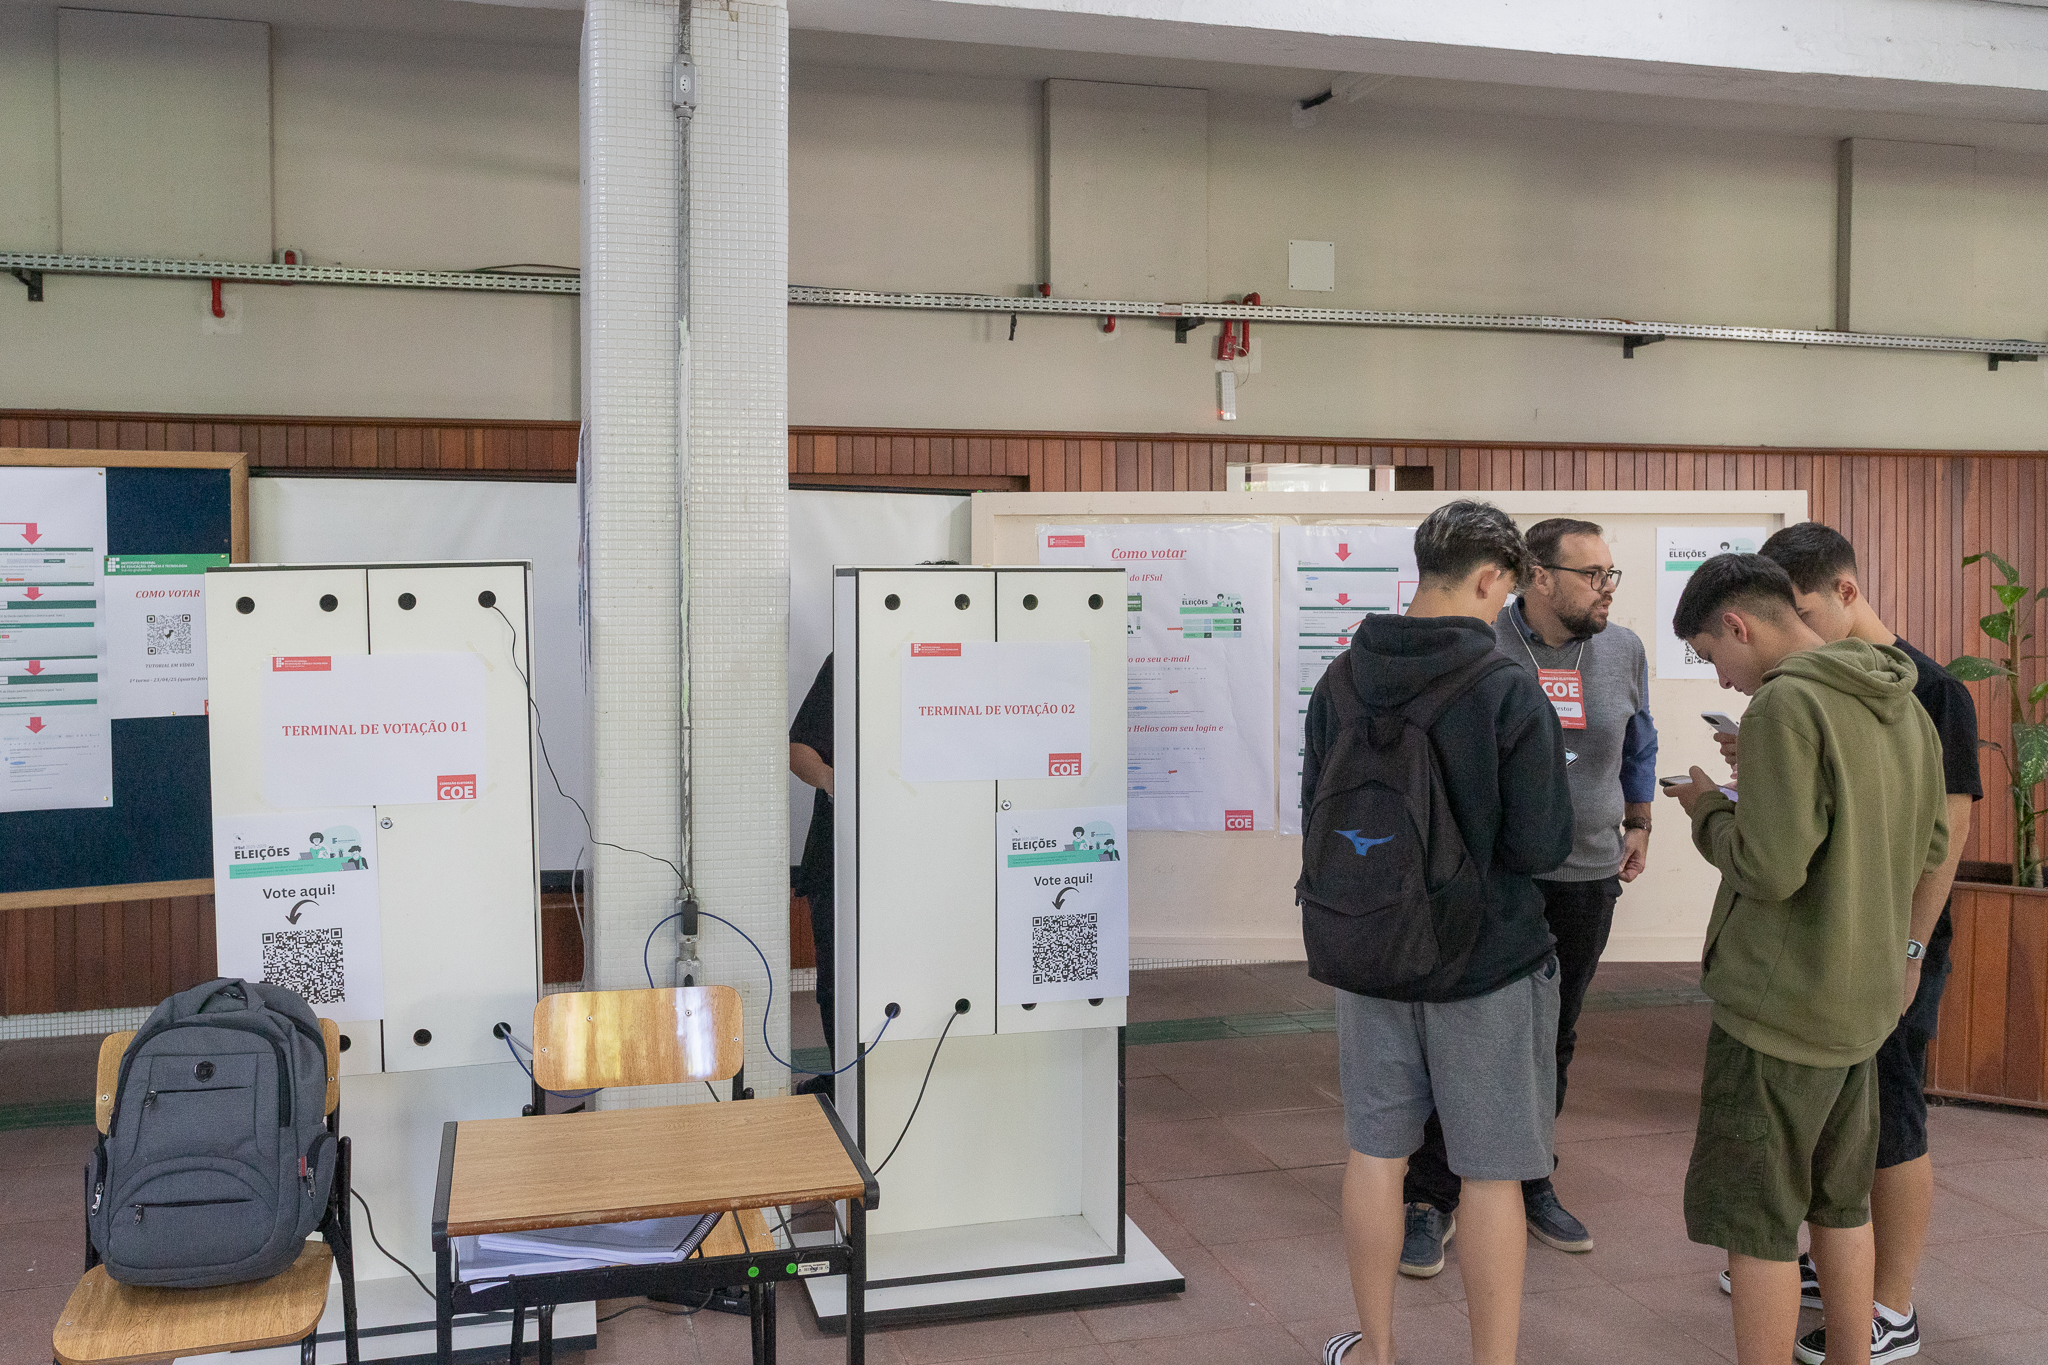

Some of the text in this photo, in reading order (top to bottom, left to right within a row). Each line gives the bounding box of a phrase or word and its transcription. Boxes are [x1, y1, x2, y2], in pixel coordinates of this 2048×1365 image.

[1111, 548, 1187, 559] Como votar
[1669, 549, 1707, 559] ELEIÇÕES
[1141, 574, 1162, 582] IFSul
[135, 590, 201, 598] COMO VOTAR
[1541, 682, 1580, 698] COE
[918, 702, 1076, 717] TERMINAL DE VOTAÇÃO 02
[282, 720, 468, 736] TERMINAL DE VOTAÇÃO 01
[1196, 724, 1217, 734] login
[1050, 763, 1079, 776] COE
[440, 786, 474, 800] COE
[1226, 818, 1252, 828] COE
[1012, 838, 1057, 851] ELEIÇÕES
[234, 846, 290, 860] ELEIÇÕES
[1034, 873, 1093, 886] Vote aqui!
[262, 884, 336, 899] Vote aqui!
